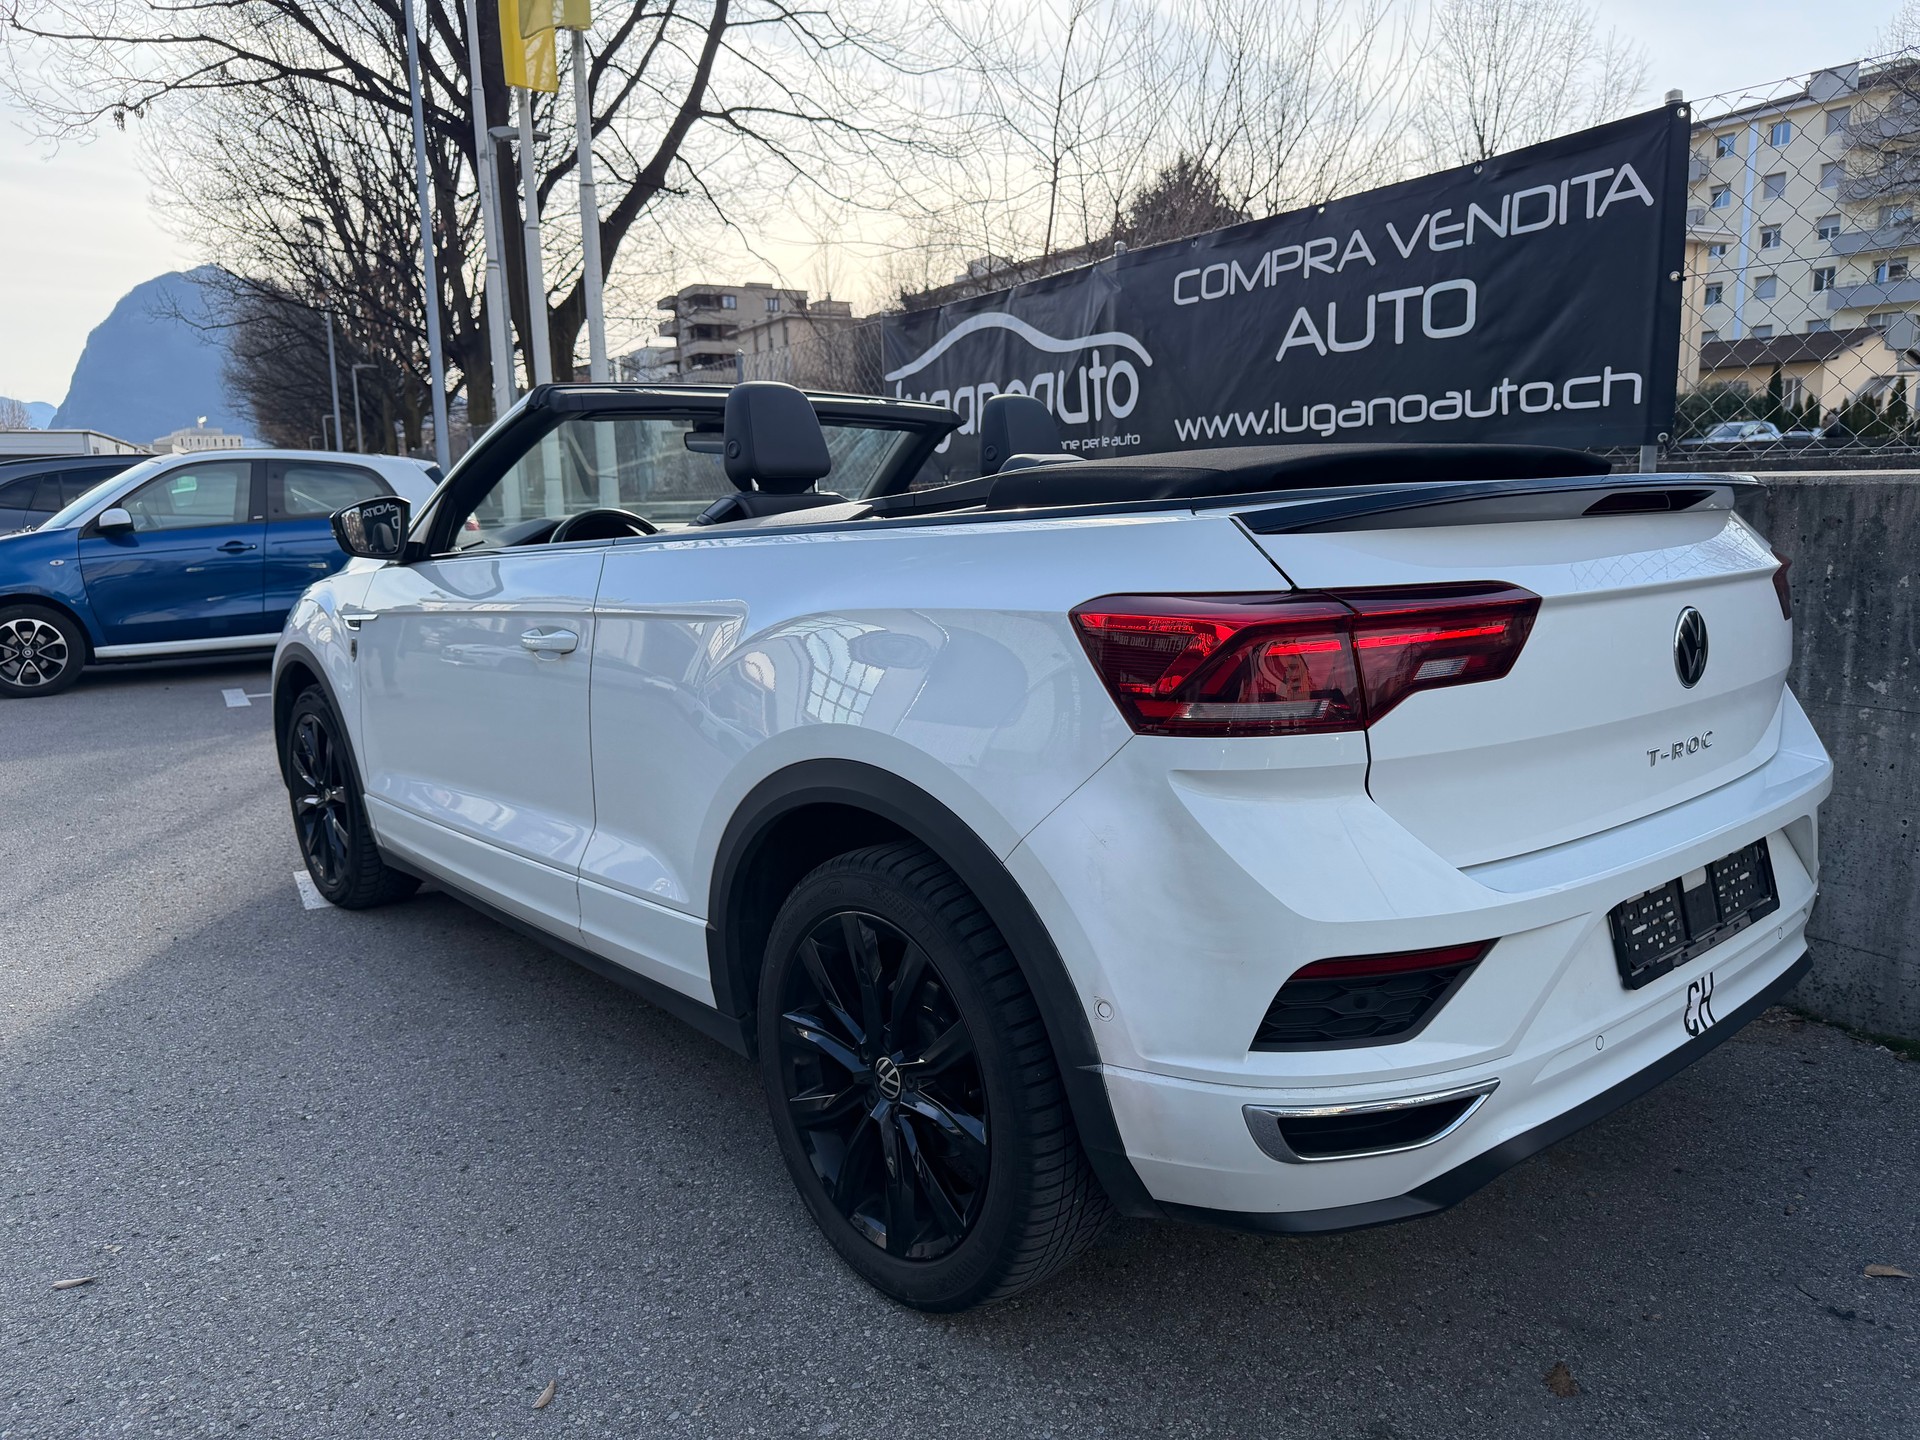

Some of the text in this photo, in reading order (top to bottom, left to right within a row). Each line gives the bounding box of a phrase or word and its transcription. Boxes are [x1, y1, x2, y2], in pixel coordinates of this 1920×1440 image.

[1174, 163, 1655, 306] COMPRA VENDITA
[1275, 278, 1477, 362] AUTO
[1174, 366, 1643, 442] www.luganoauto.ch
[1081, 438, 1100, 451] per
[1111, 433, 1141, 446] auto
[1646, 729, 1713, 767] T-ROC
[1684, 972, 1717, 1037] CH
